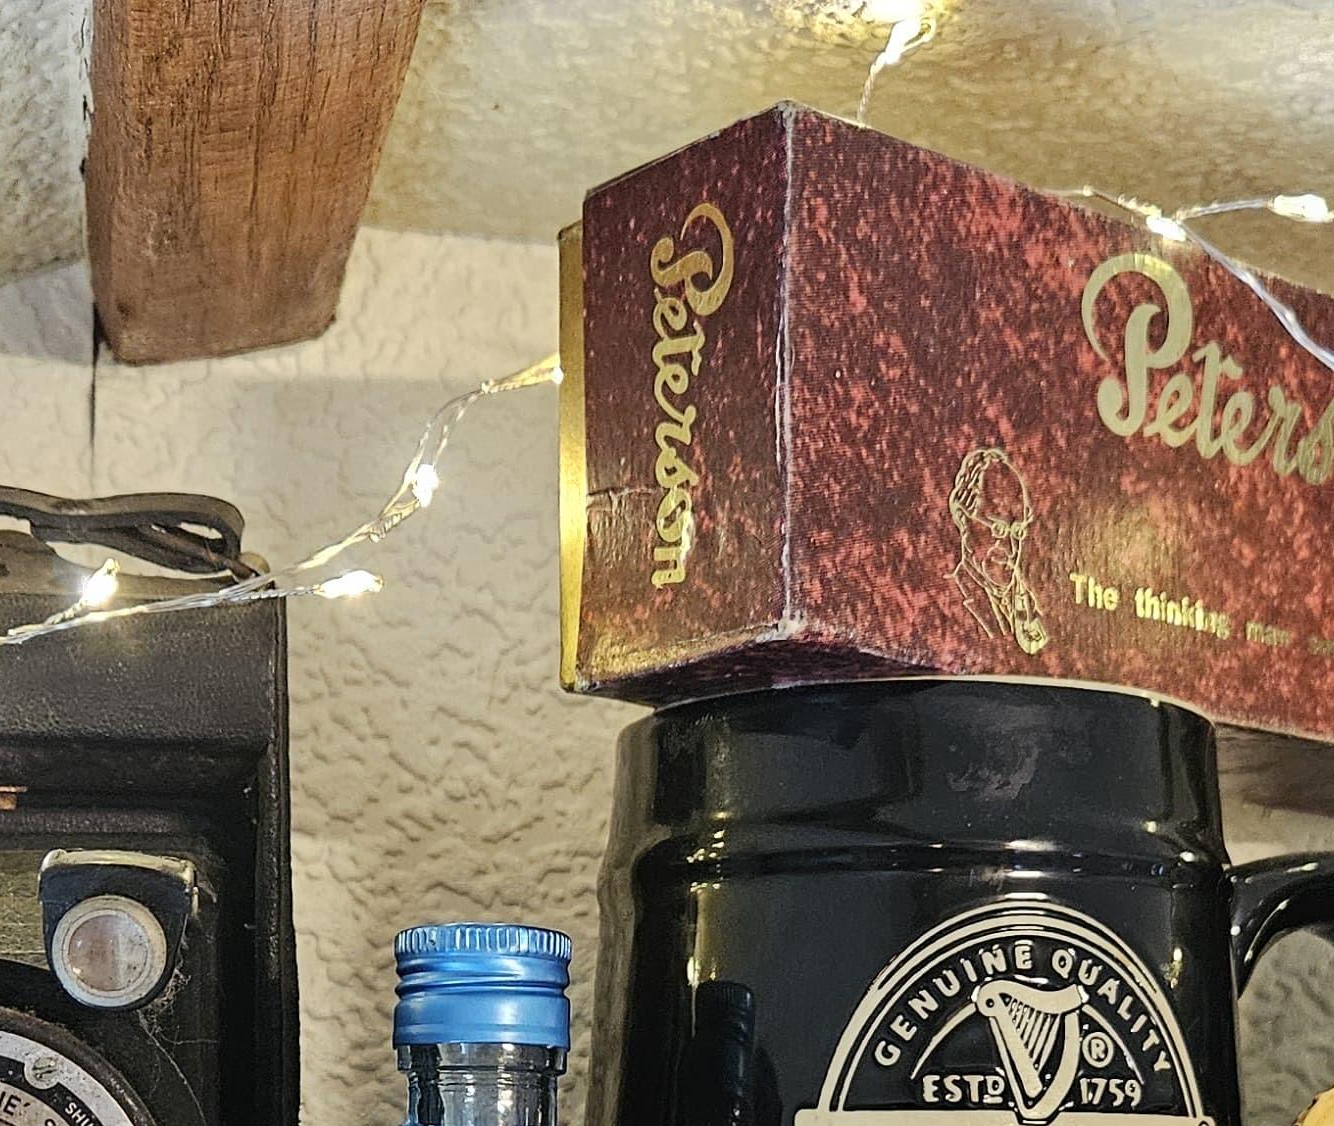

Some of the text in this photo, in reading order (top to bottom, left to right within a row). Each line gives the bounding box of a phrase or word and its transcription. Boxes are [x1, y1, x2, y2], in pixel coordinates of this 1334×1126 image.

[651, 202, 734, 589] Peterson
[1069, 572, 1120, 611] The
[1135, 587, 1231, 640] thinking
[874, 941, 1172, 1075] GENUINE QUALITY
[922, 1072, 1142, 1107] ESTD 1759
